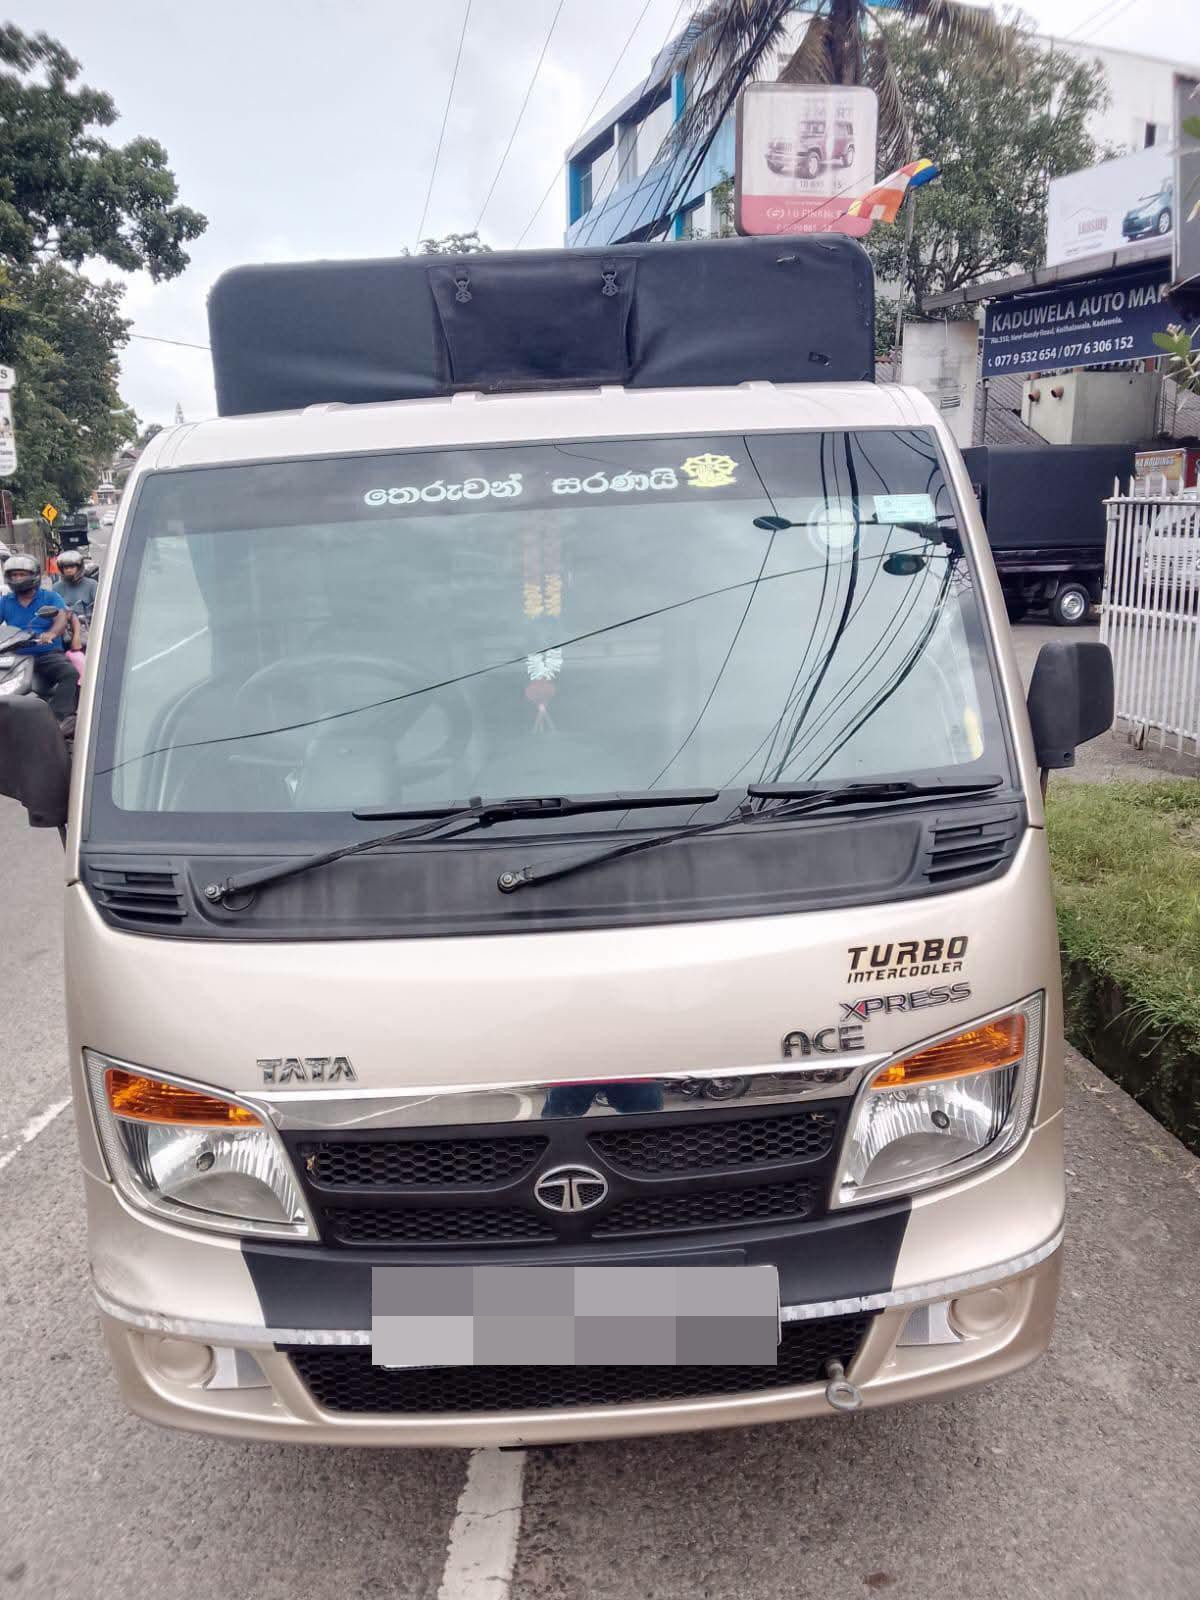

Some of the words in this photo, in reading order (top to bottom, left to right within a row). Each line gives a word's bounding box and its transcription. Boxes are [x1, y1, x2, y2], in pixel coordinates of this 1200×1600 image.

[991, 299, 1075, 332] KADUWELA
[1078, 292, 1124, 321] AUTO
[994, 354, 1012, 367] 077
[1038, 347, 1057, 361] 654
[1063, 343, 1082, 357] 077
[1093, 339, 1112, 352] 306
[1116, 336, 1134, 350] 152
[363, 472, 523, 507] තෙරුවන්
[550, 467, 679, 495] සරණයි
[847, 935, 969, 971] TURBO
[847, 961, 963, 984] INTERCOOLER
[839, 981, 972, 1022] XPRESS
[781, 1024, 865, 1058] ACE
[256, 1055, 359, 1084] TATA
